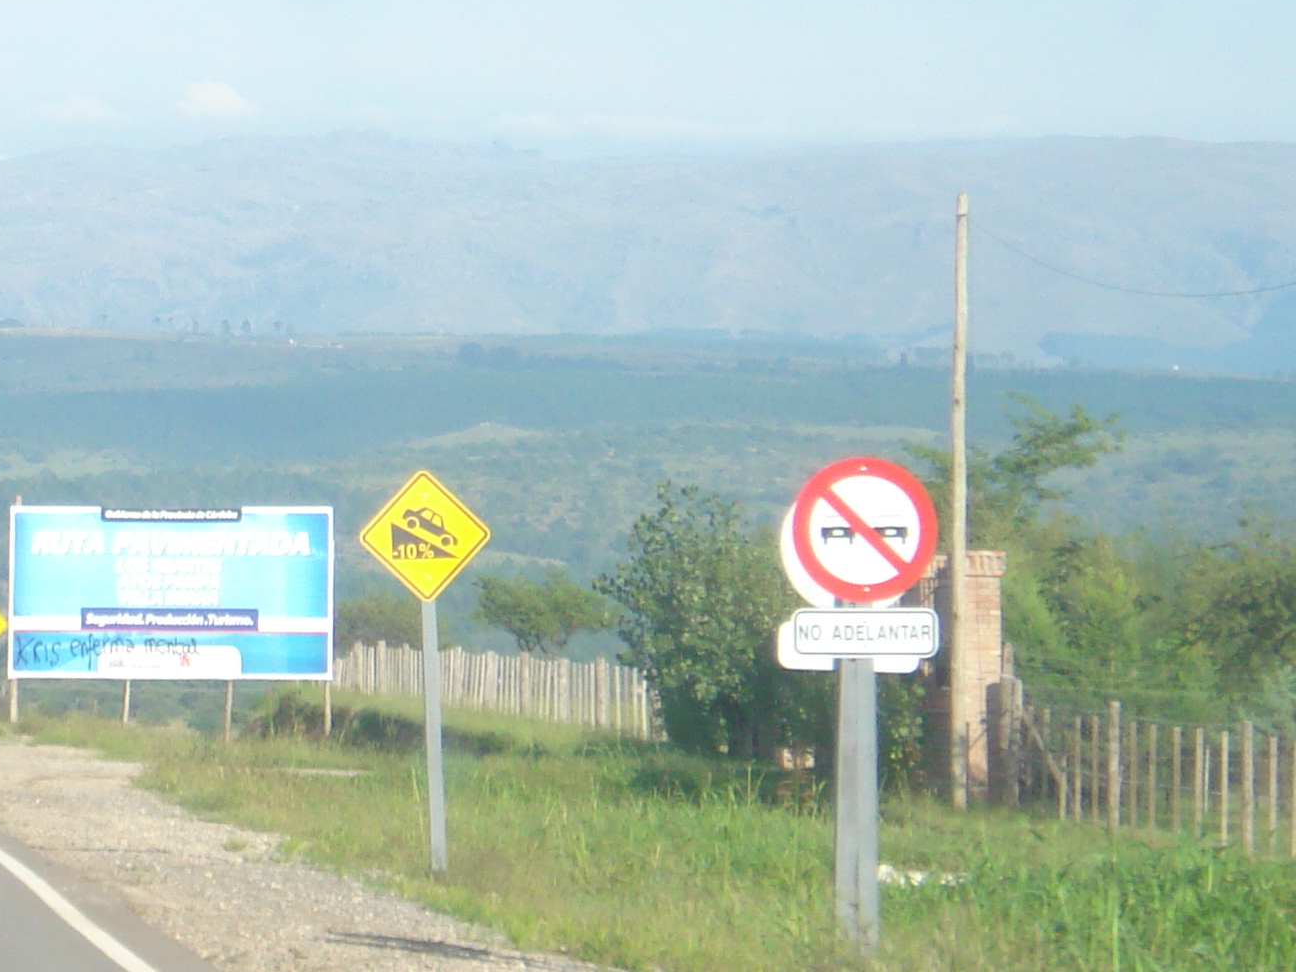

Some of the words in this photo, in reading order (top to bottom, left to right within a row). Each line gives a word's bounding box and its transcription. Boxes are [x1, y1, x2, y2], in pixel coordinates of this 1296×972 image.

[31, 530, 105, 556] RUTA
[113, 530, 311, 557] PAVIMENTADA
[798, 625, 822, 641] NO
[832, 625, 932, 641] ADELANTAR
